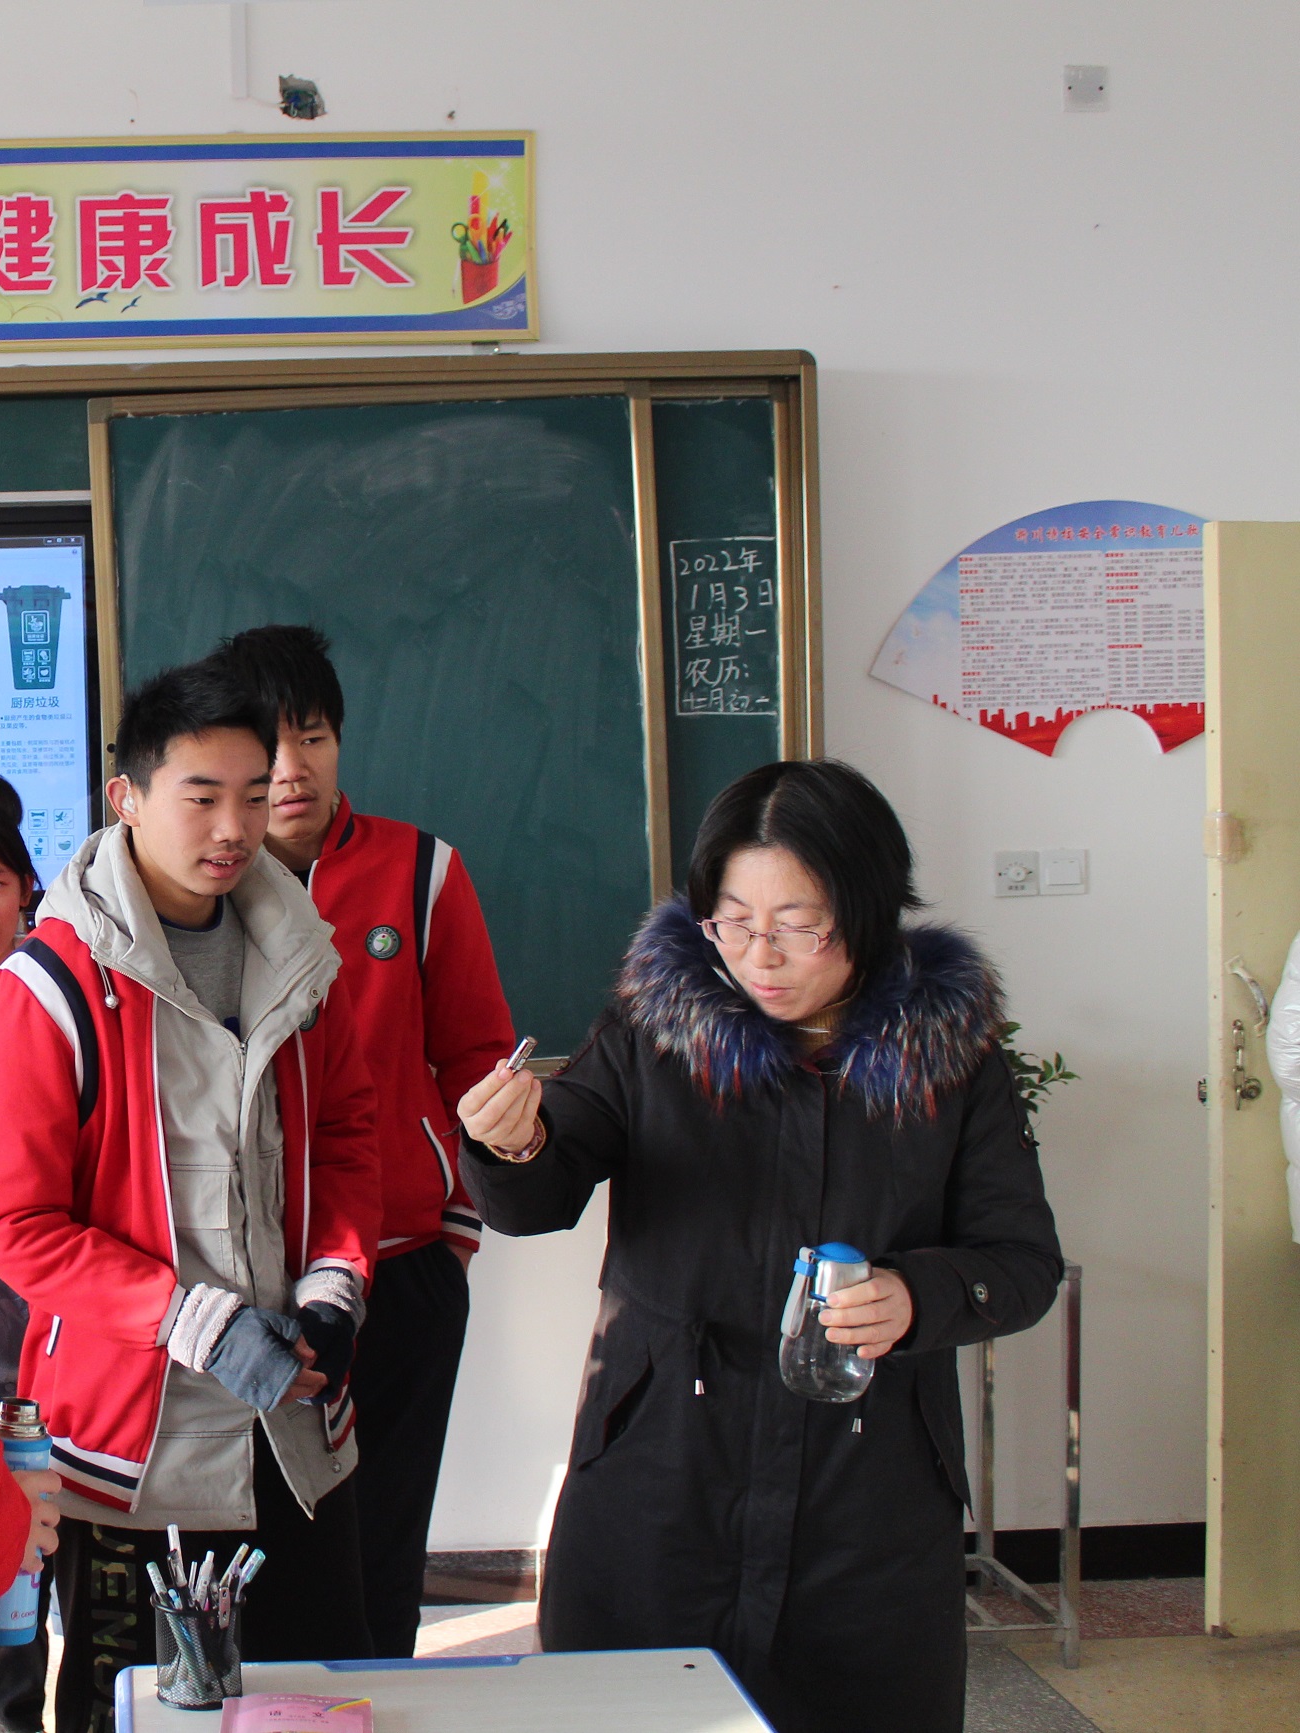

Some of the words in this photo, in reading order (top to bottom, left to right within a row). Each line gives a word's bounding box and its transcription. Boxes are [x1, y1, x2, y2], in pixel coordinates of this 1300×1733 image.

[679, 546, 763, 576] 2022年
[690, 578, 774, 612] 1月3日
[685, 612, 768, 650] 星期一
[11, 697, 59, 708] 厨房垃圾
